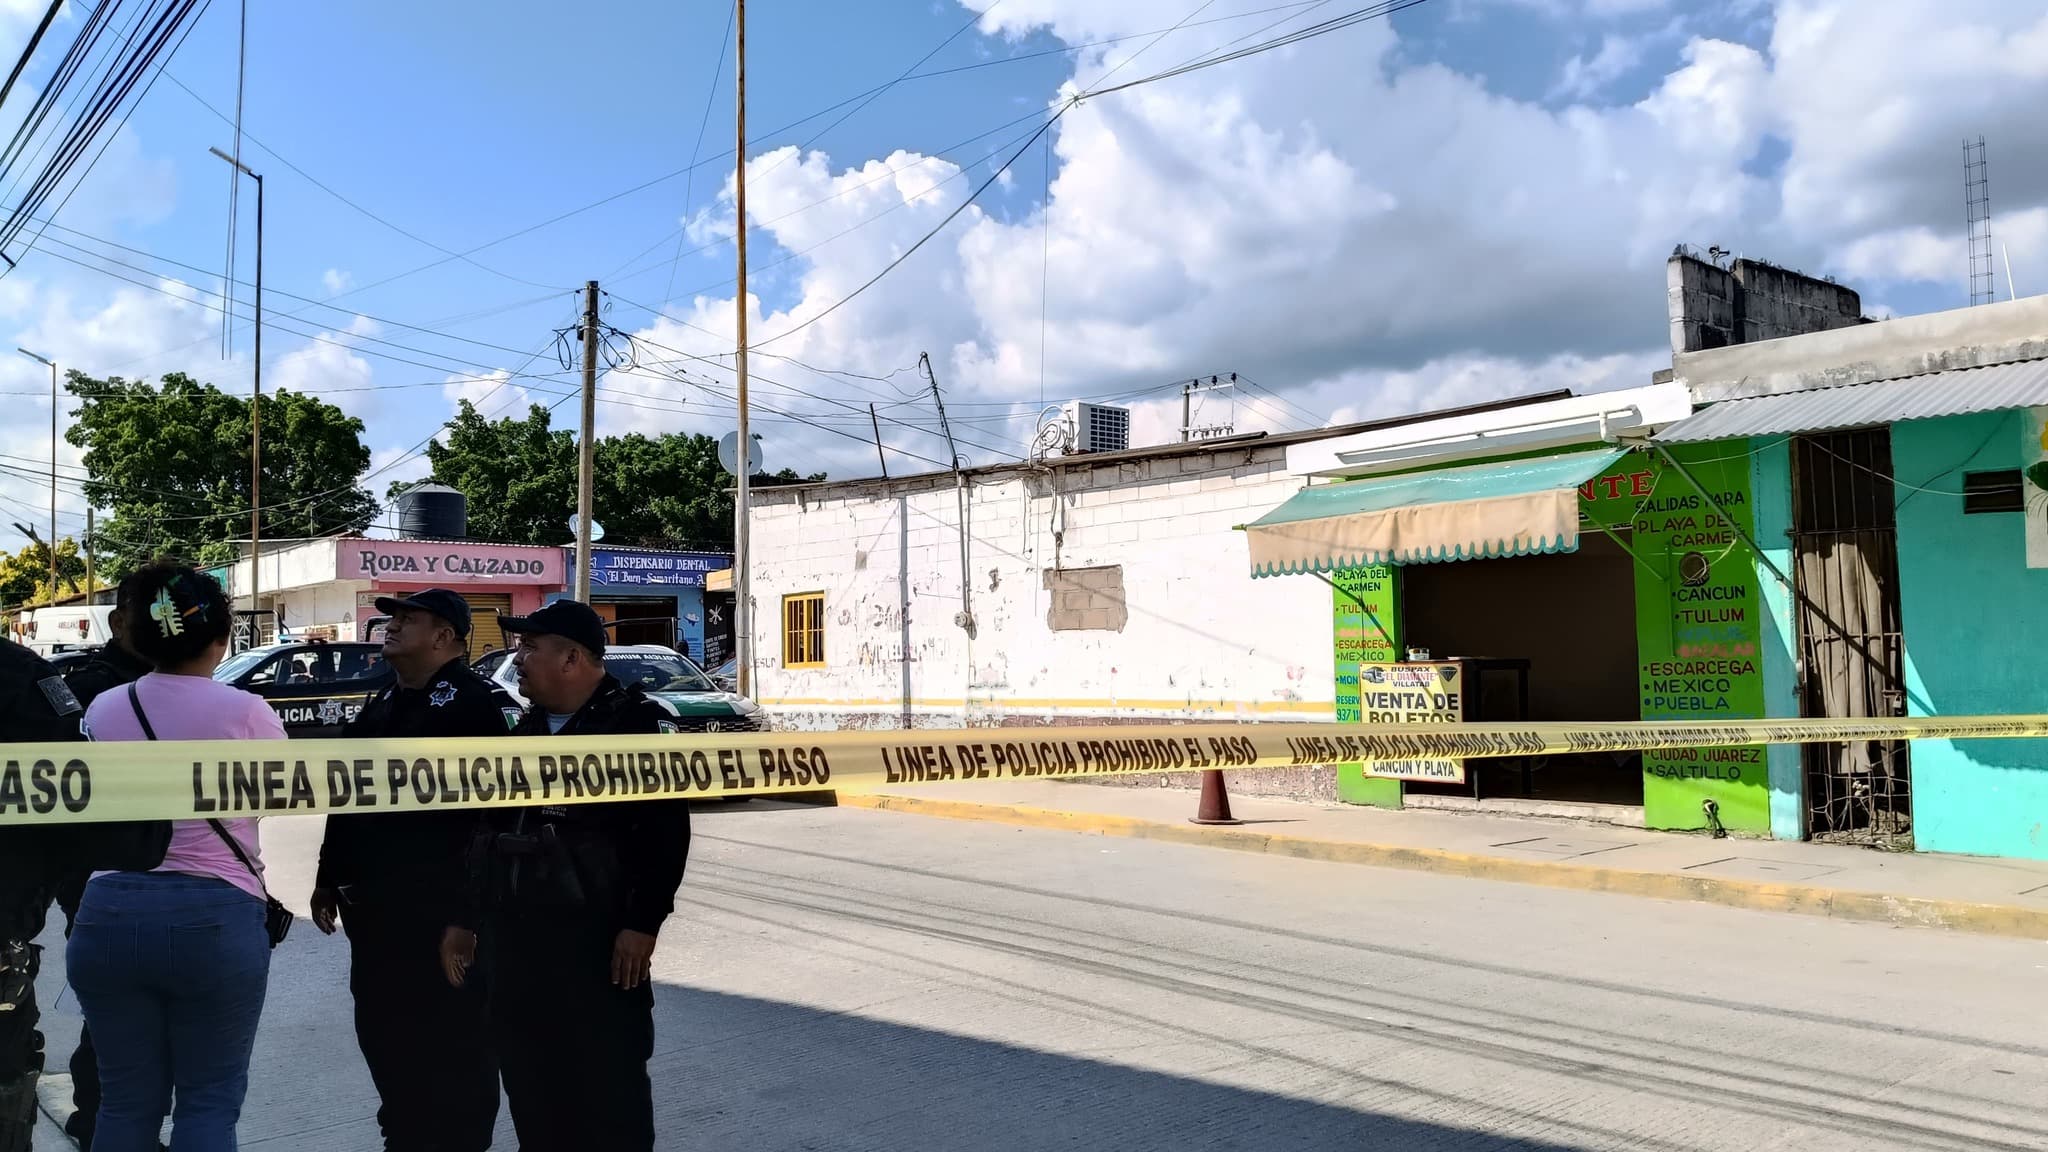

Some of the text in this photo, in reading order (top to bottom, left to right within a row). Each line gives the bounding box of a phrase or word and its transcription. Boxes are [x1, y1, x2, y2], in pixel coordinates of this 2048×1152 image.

[1635, 494, 1700, 514] SALIDAS
[1638, 516, 1697, 534] PLAYA
[359, 550, 545, 577] ROPA Y CALZADO
[612, 556, 711, 571] DISPENSARIO DENTAL
[1337, 568, 1388, 580] PLAYA DEL
[1340, 581, 1381, 592] CARMEN
[1676, 585, 1746, 602] CANCUN
[1679, 607, 1745, 624] TULUM
[1338, 639, 1392, 650] ESCARCEGA
[1340, 651, 1385, 662] MEXICO
[1650, 660, 1756, 676] ESCARCEGA
[1653, 677, 1731, 694] MEXICO
[1364, 692, 1459, 711] VENTA DE
[1653, 695, 1730, 711] PUEBLA
[276, 707, 315, 723] LICIA
[1336, 708, 1351, 722] 937
[1368, 711, 1457, 723] BOLETOS
[1286, 731, 1546, 764] LINEA DE POLICIA PROHIBIDO EL PASO
[1650, 747, 1761, 764] CIUDAD JUAREZ
[881, 735, 1258, 783] LINEA DE POLICIA PROHIBIDO EL PASO
[1373, 760, 1456, 777] CANCUN Y PLAYA
[1655, 764, 1741, 780] SALTILLO
[0, 759, 91, 814] ASO
[192, 747, 831, 812] LINEA DE POLICIA PROHIBIDO EL PASO
